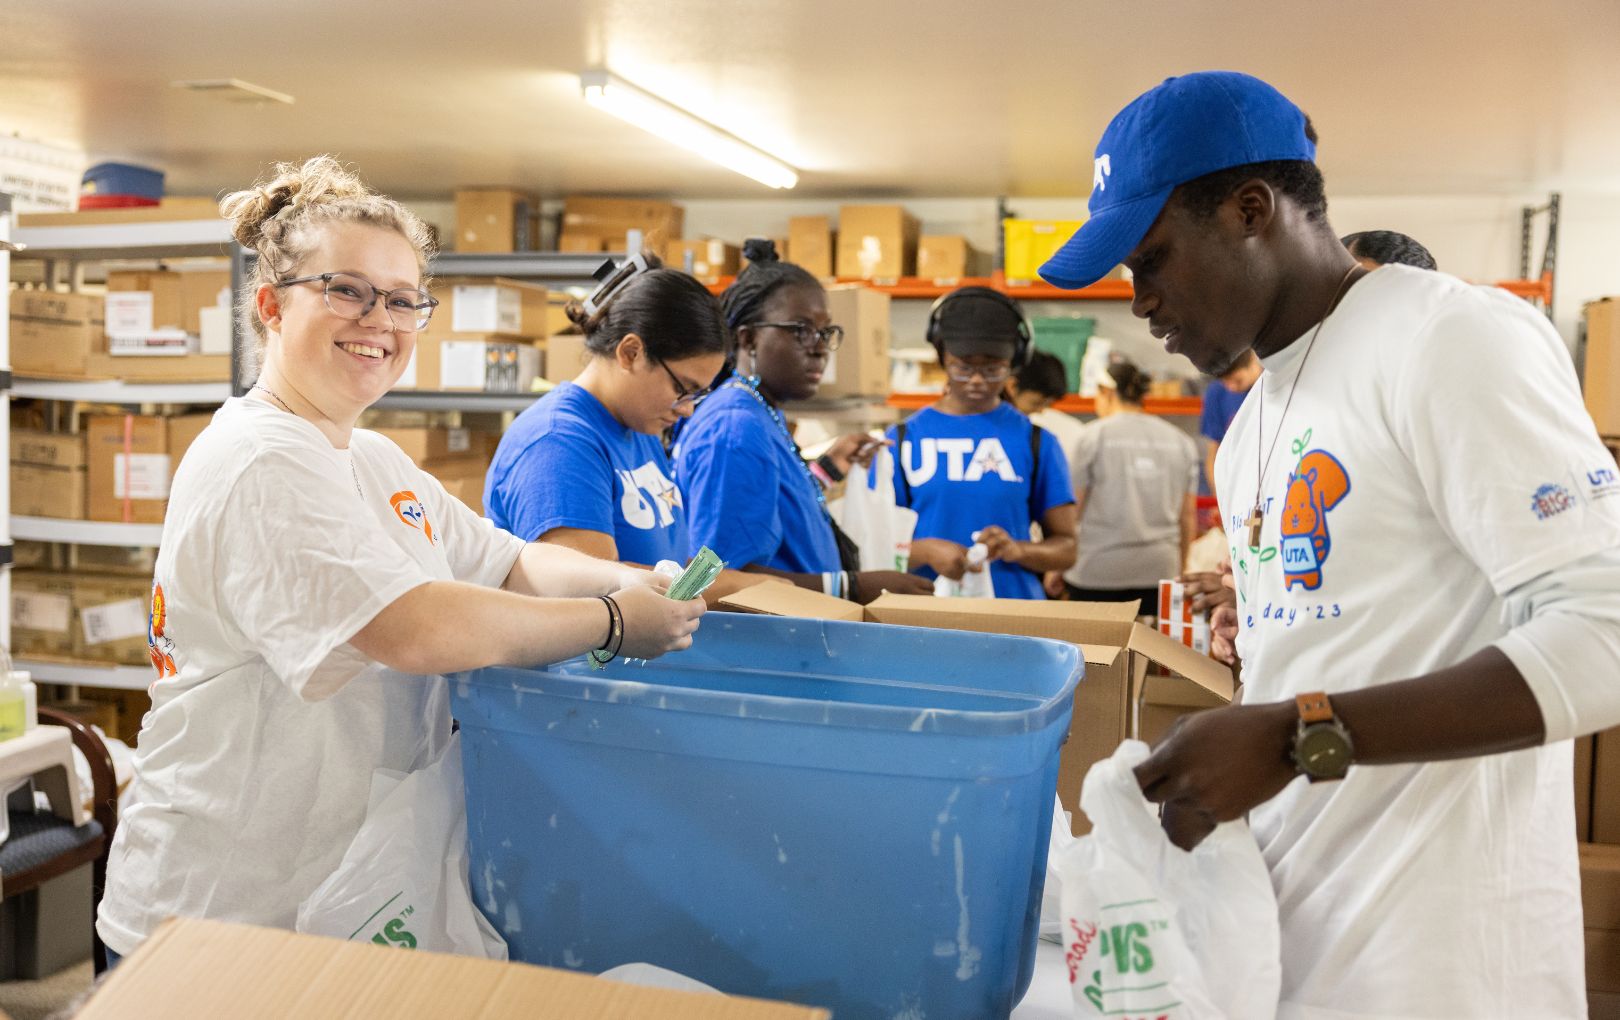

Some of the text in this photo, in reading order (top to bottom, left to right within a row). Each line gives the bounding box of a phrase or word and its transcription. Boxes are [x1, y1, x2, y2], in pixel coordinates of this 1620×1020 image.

[901, 437, 1018, 488] UTA
[1285, 546, 1310, 564] UTA
[1262, 601, 1297, 627] day
